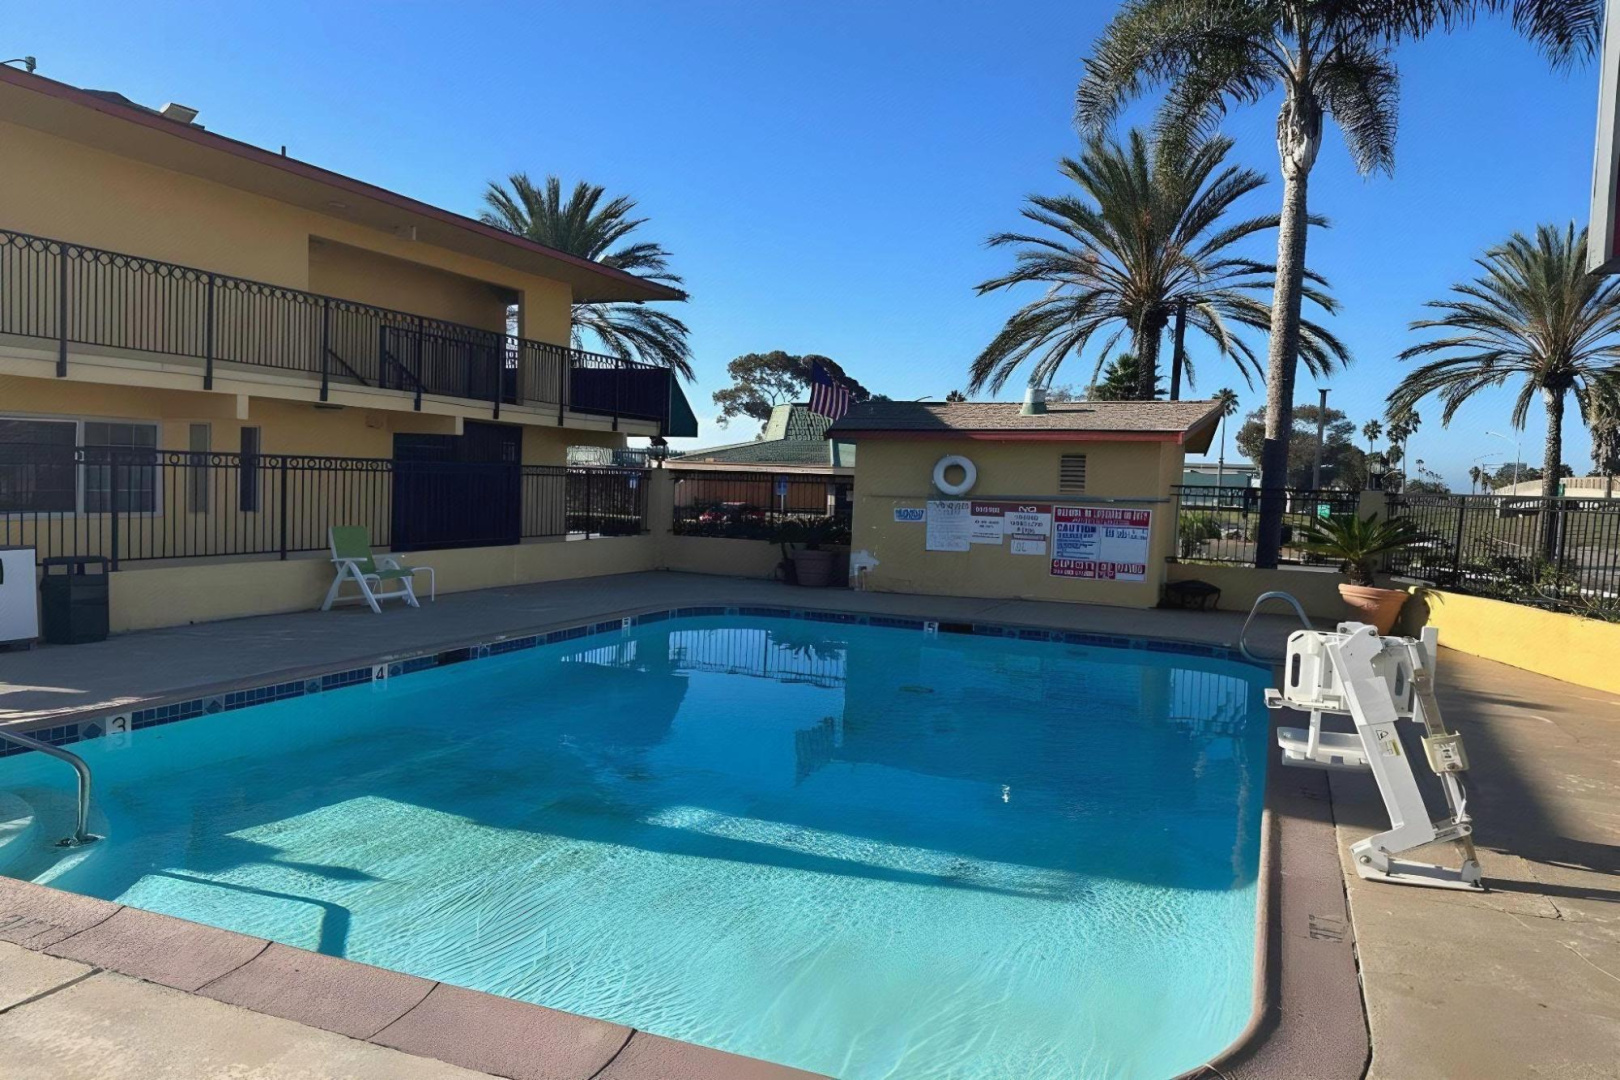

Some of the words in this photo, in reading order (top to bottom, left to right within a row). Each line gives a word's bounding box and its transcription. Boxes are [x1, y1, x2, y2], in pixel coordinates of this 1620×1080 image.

[1056, 523, 1097, 533] CAUTION
[376, 666, 385, 680] 4
[111, 716, 126, 735] 3
